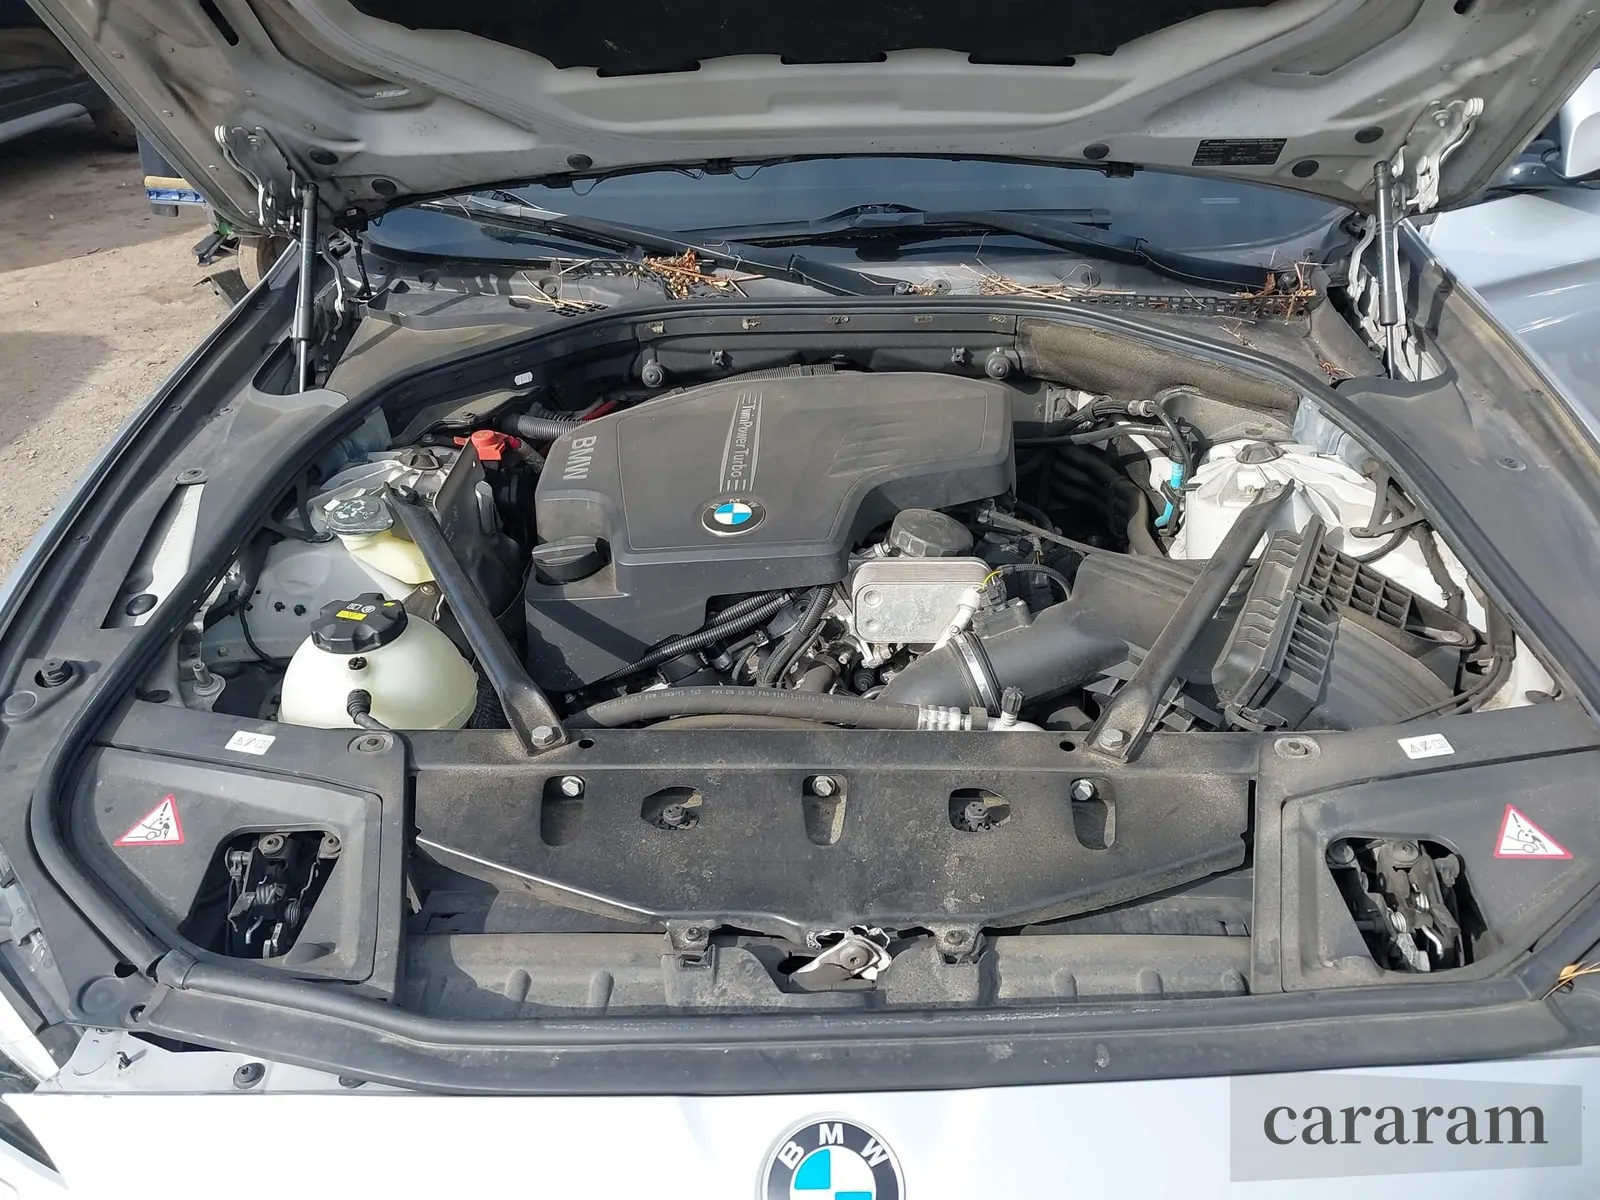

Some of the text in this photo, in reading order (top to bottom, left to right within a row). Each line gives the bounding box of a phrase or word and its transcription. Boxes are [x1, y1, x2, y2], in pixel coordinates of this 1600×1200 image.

[563, 435, 598, 480] BMW
[730, 403, 756, 478] TwinPower Turbo
[710, 498, 760, 510] BMW
[777, 1123, 889, 1170] BMW
